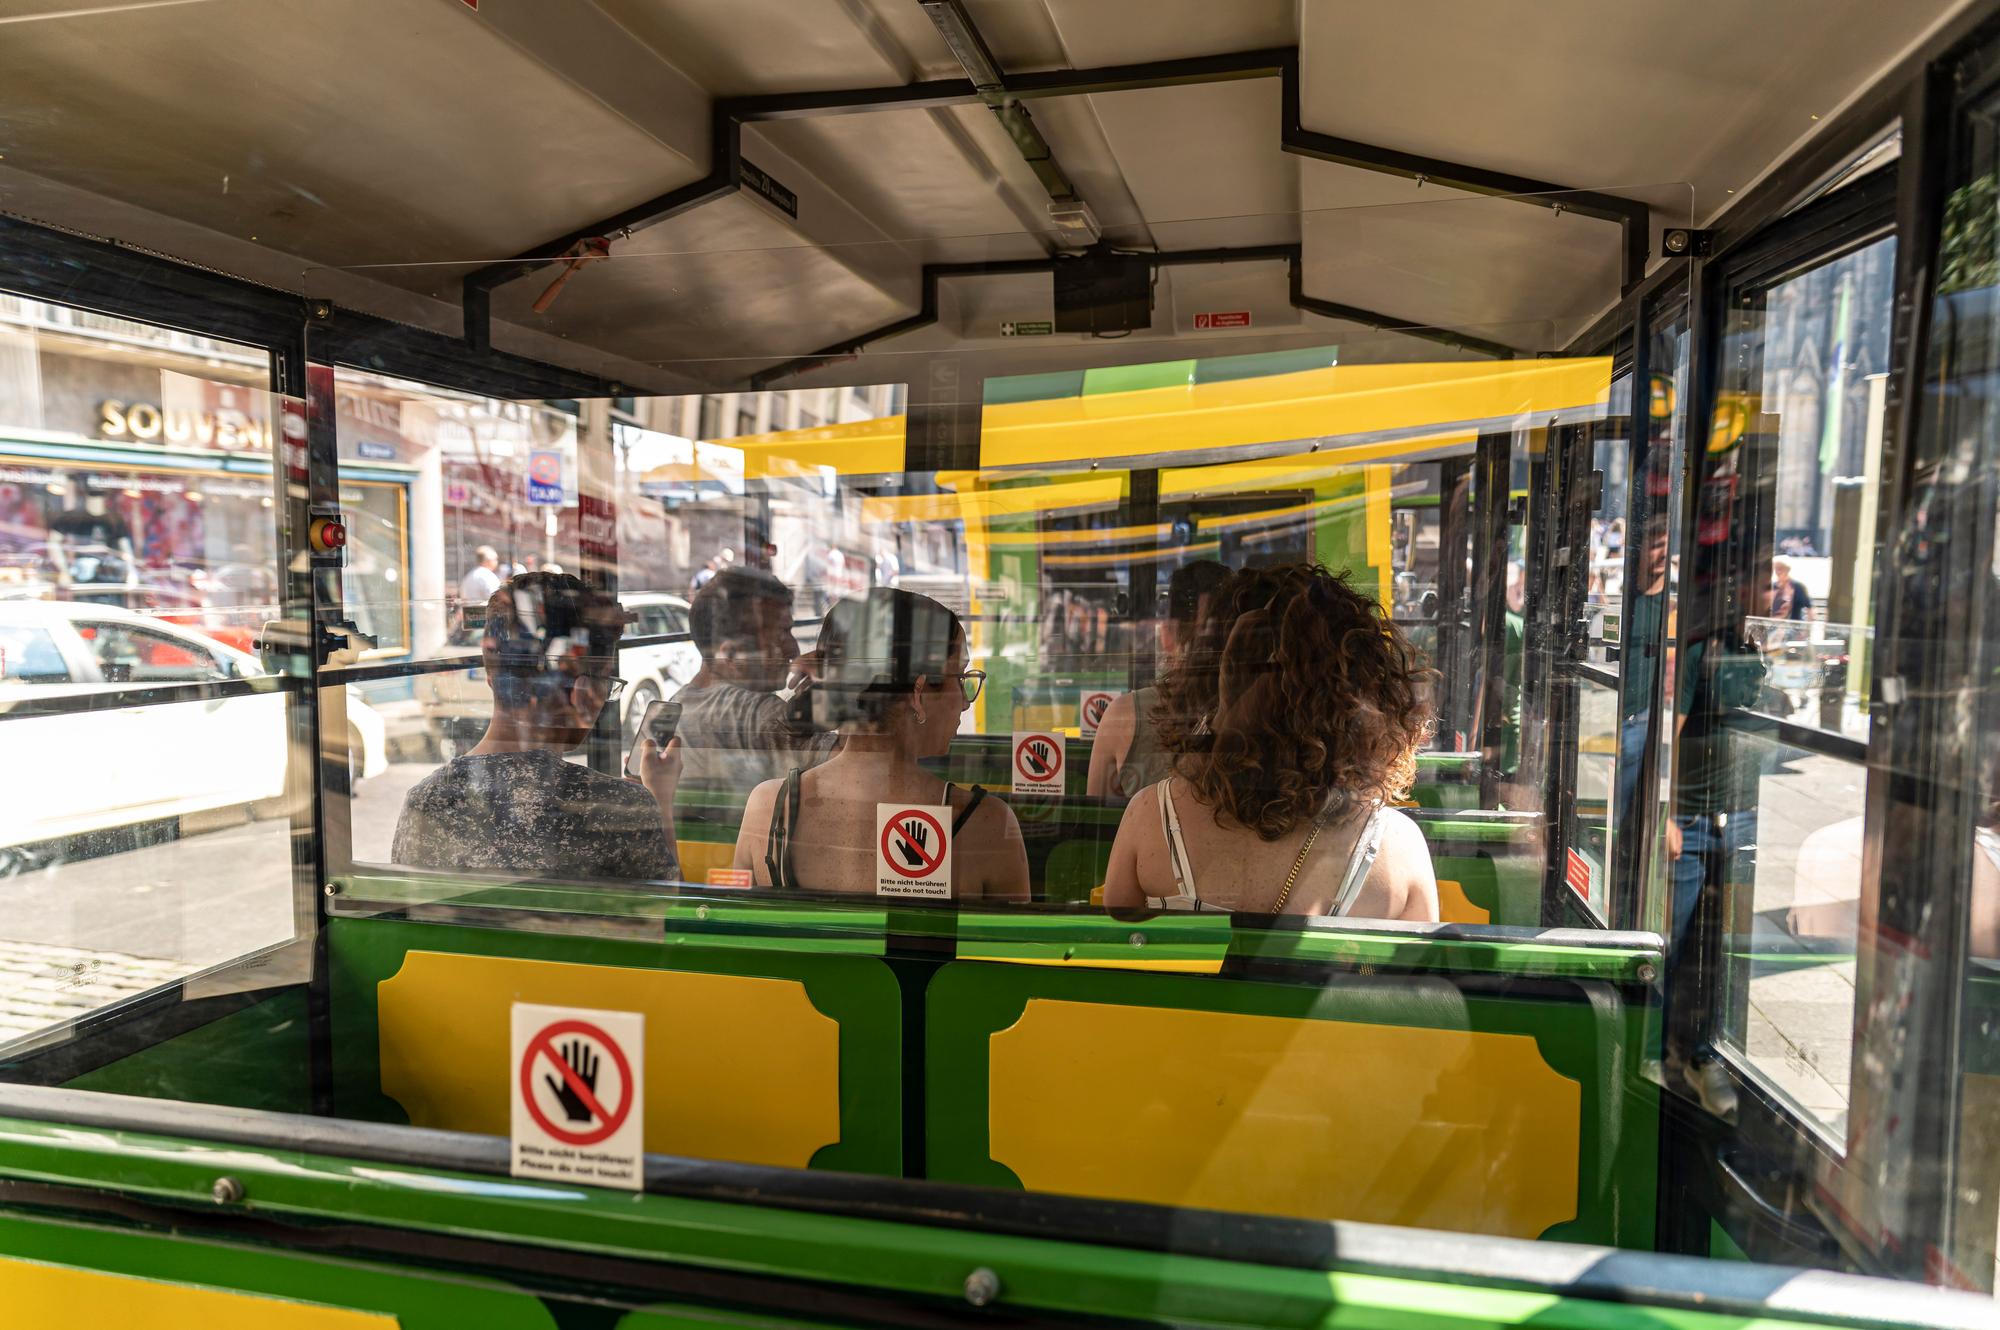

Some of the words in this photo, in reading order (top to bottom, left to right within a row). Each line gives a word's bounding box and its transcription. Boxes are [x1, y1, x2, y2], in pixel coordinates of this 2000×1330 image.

[520, 1145, 544, 1156] Bitte
[548, 1148, 575, 1159] nicht
[579, 1151, 635, 1165] berühren!
[520, 1159, 554, 1171] Please
[558, 1162, 571, 1172] do
[575, 1165, 594, 1174] not
[598, 1167, 633, 1179] touch!
